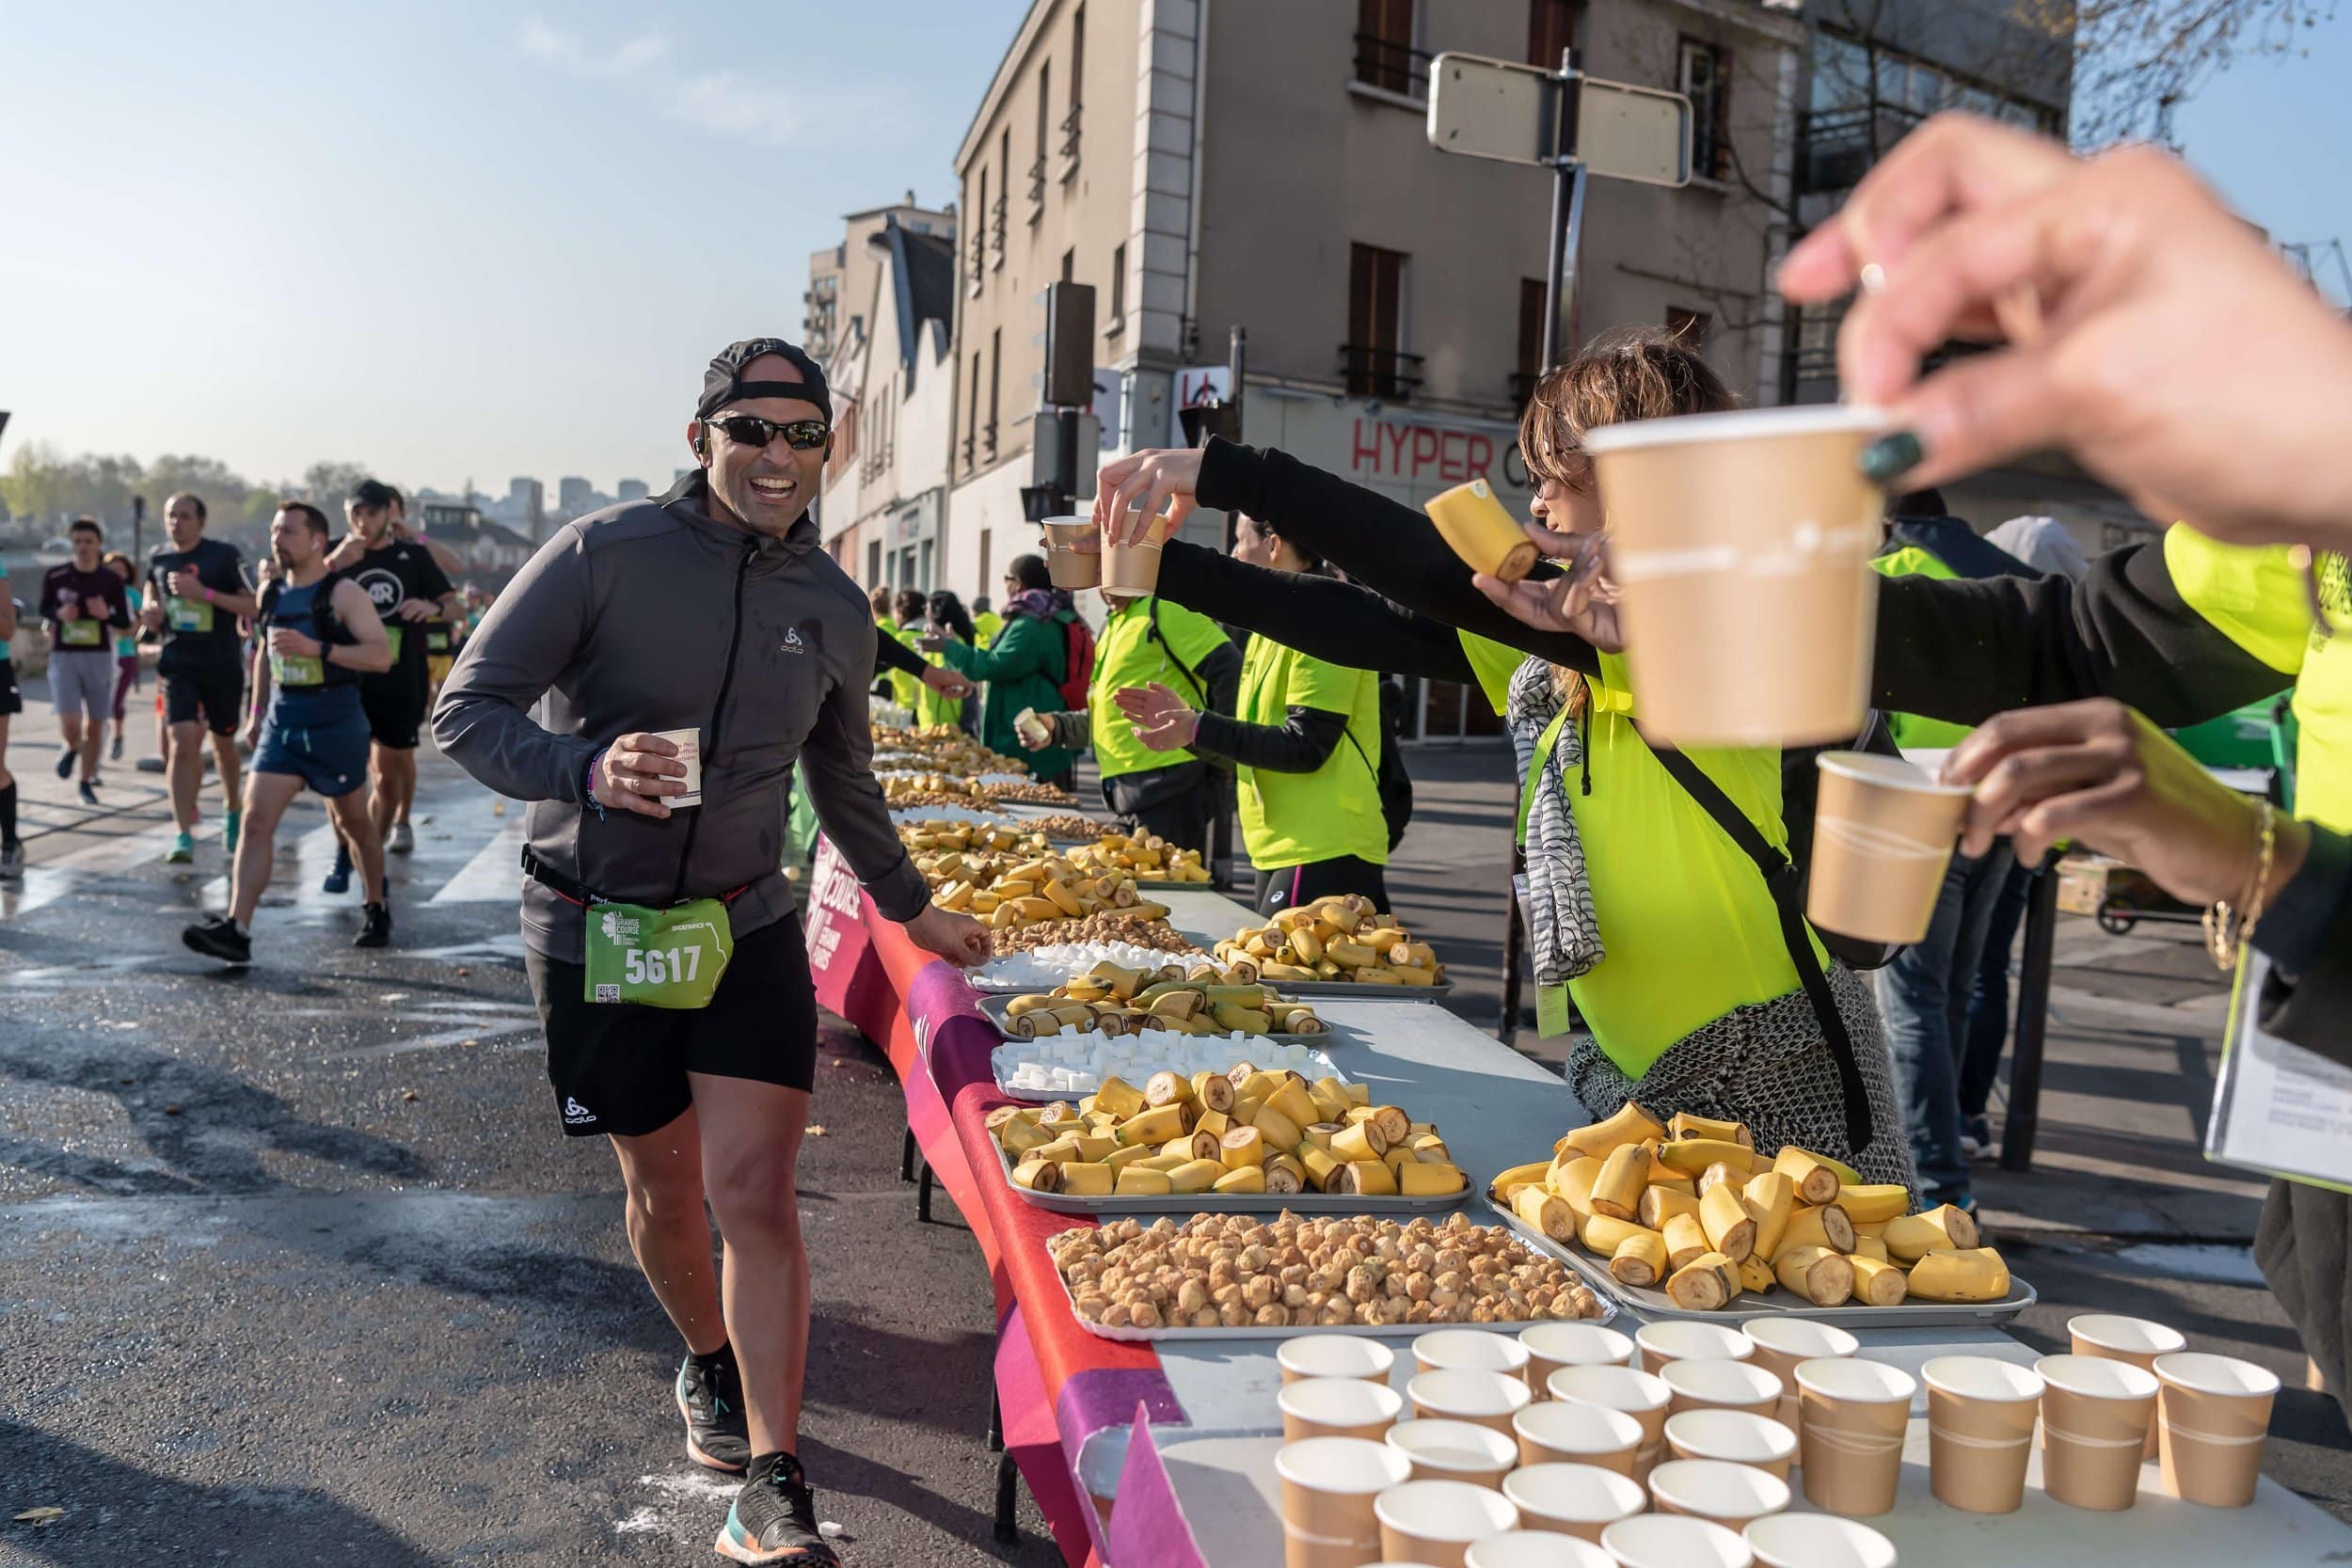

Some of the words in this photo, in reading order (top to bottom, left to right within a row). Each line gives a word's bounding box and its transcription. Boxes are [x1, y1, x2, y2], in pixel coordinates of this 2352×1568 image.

[1352, 418, 1494, 483] HYPER
[625, 944, 702, 986] 5617
[564, 1115, 597, 1124] odlo
